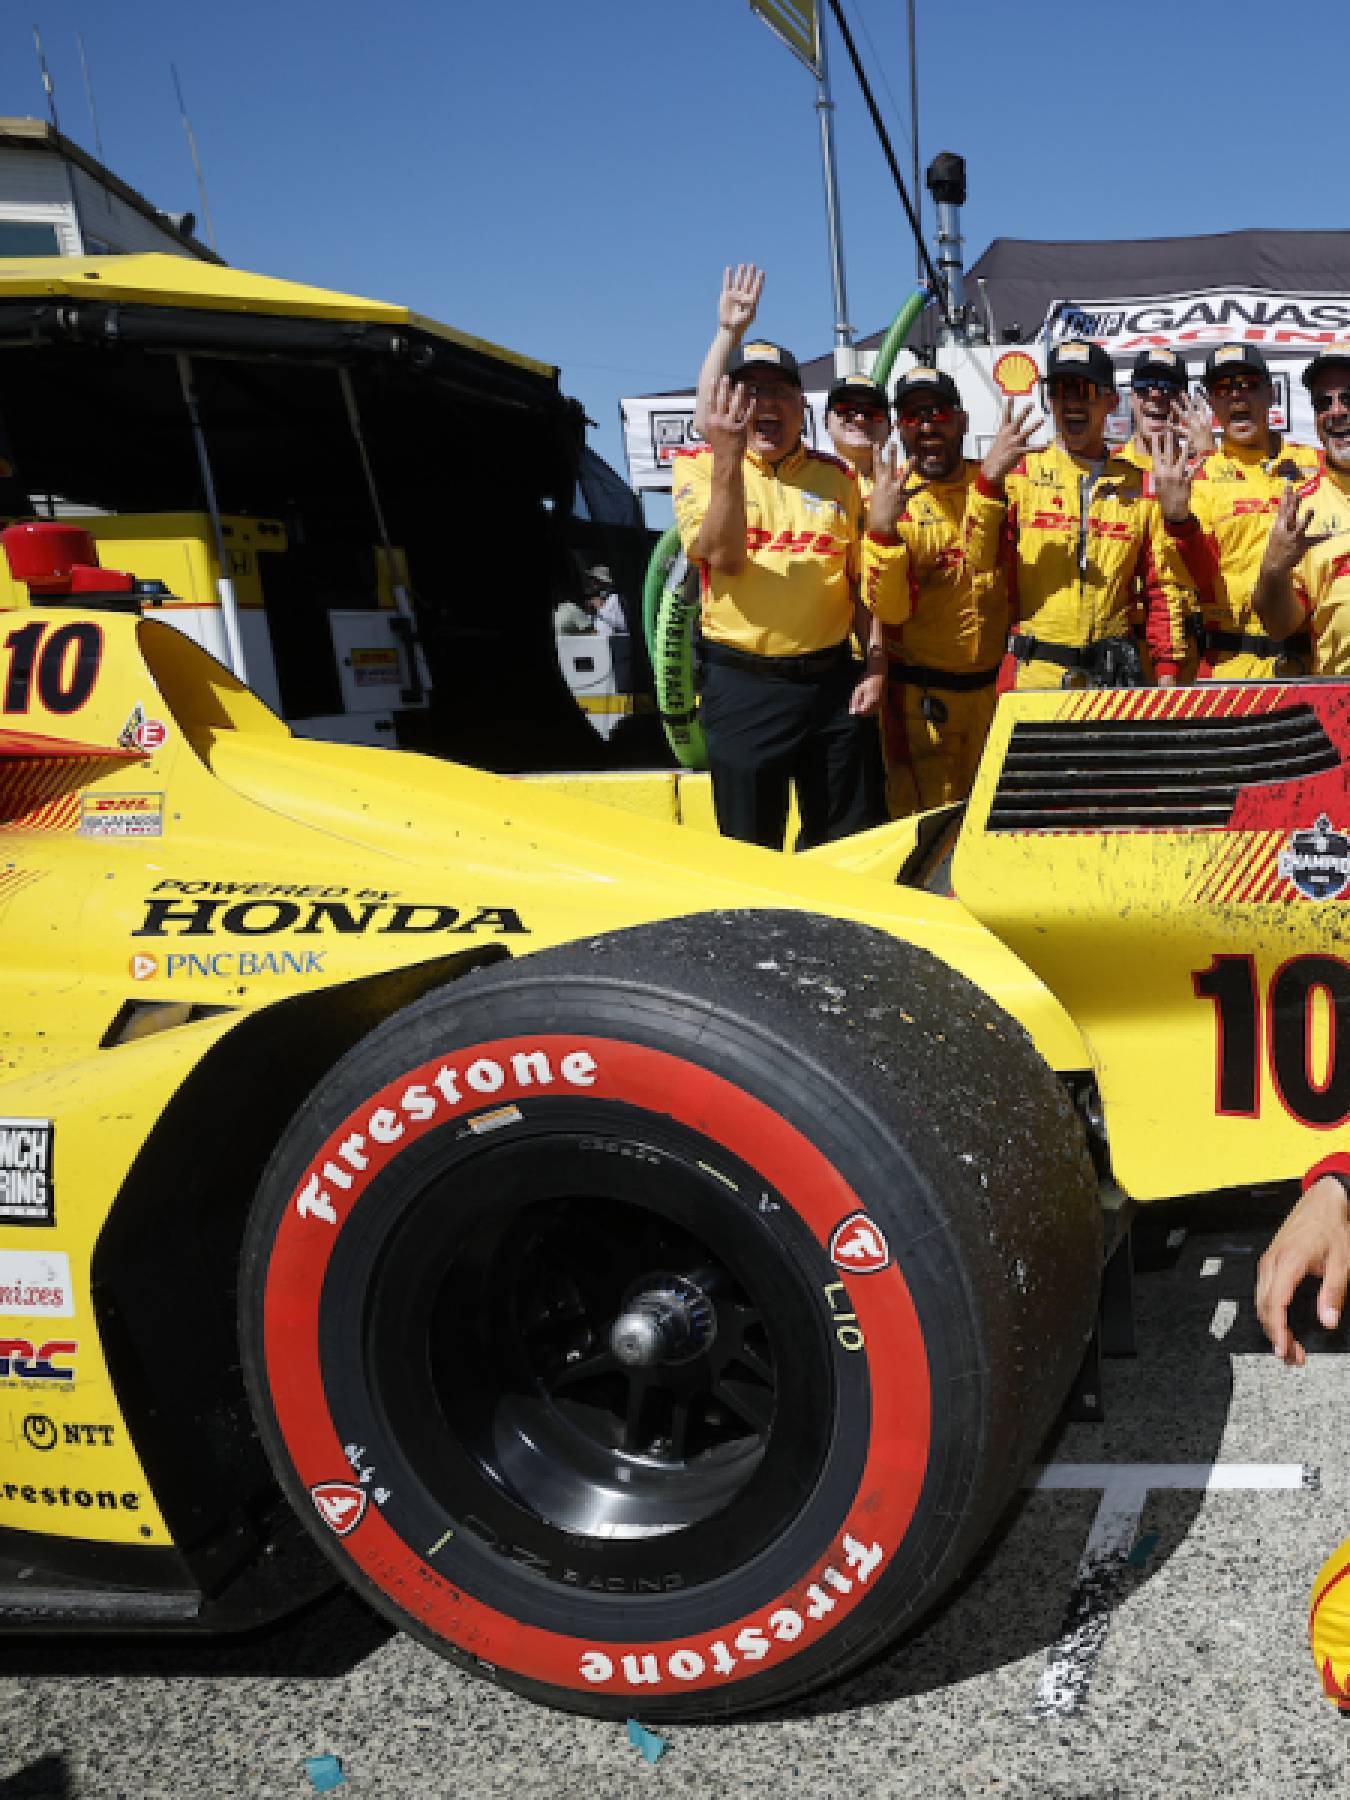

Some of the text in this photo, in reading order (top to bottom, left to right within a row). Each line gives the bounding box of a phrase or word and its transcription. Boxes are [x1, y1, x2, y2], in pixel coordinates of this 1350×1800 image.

[3, 620, 104, 715] 10
[152, 878, 349, 898] POWERED
[131, 898, 532, 937] HONDA
[166, 951, 328, 979] PNC BANK
[296, 1050, 598, 1225] Firestone
[62, 1423, 115, 1446] NTT
[0, 1482, 140, 1511] restone
[580, 1533, 885, 1685] Firestone
